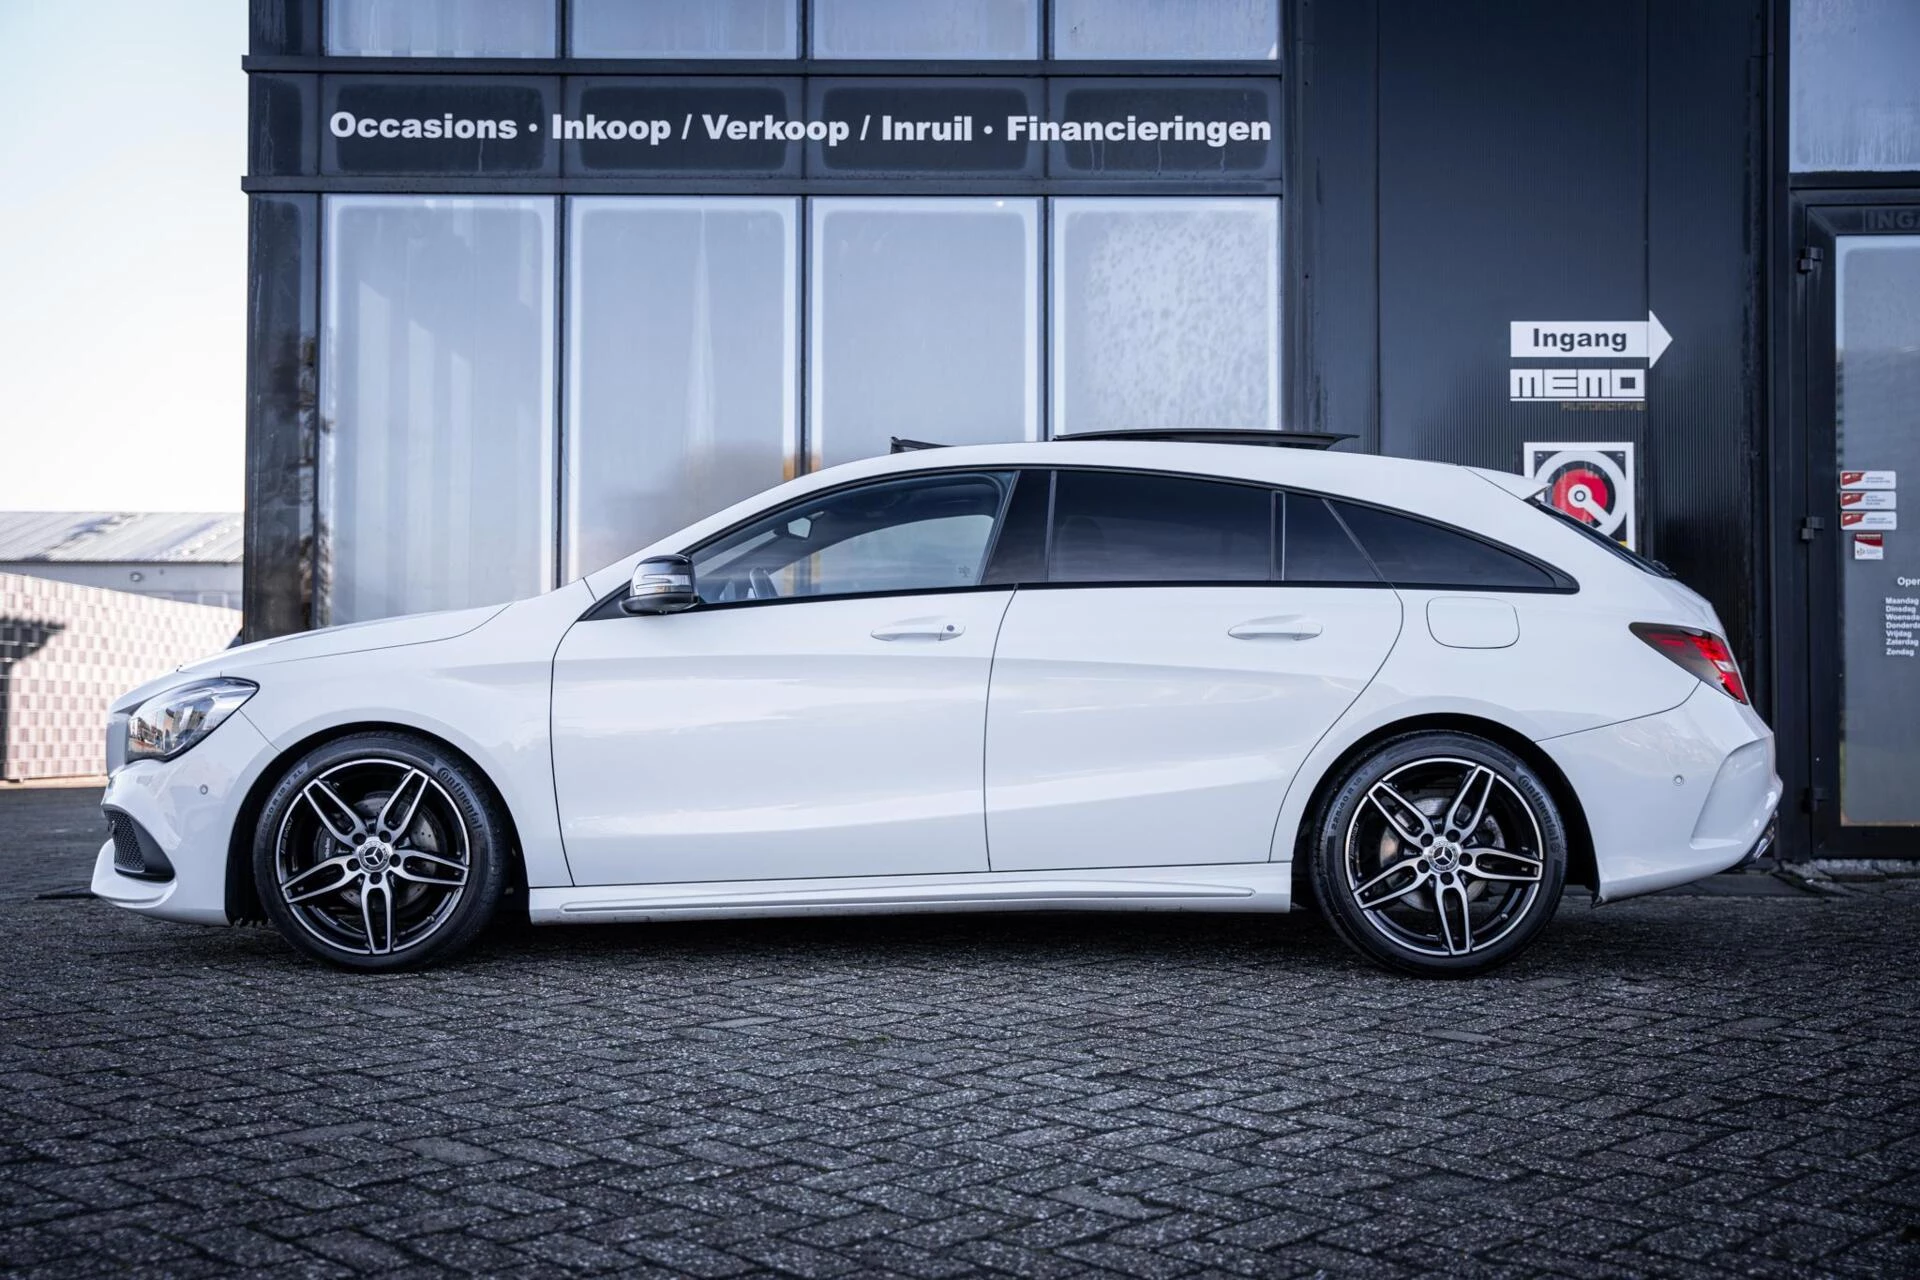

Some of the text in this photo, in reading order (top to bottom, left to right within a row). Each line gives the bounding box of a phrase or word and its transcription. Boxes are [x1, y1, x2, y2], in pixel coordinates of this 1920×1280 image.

[329, 111, 518, 139] Occasions
[552, 114, 671, 146] Inkoop
[702, 114, 850, 147] Verkoop
[882, 115, 972, 141] Inruil
[1007, 115, 1272, 148] Financieringen
[1868, 211, 1920, 228] ING
[1533, 327, 1627, 353] Ingang
[1510, 368, 1645, 398] MEMO
[1885, 596, 1920, 606] Maandag
[1885, 605, 1917, 614] Dinsdag
[1885, 630, 1913, 639] Vrijdag
[1885, 638, 1919, 647] Zaterdag
[1885, 647, 1915, 657] Zondag
[436, 766, 484, 830] Continental
[1518, 774, 1560, 841] Continental
